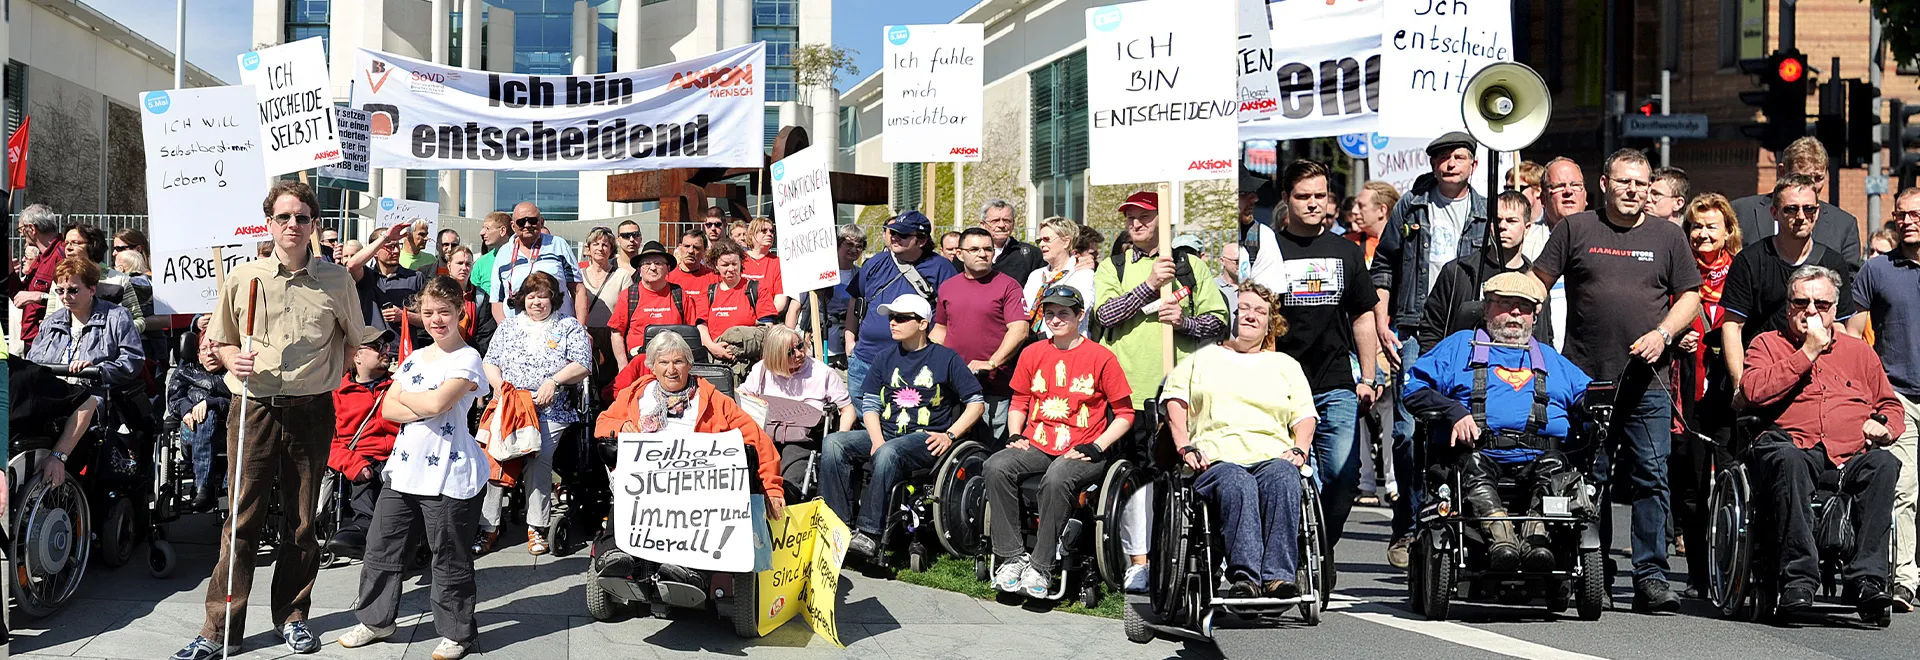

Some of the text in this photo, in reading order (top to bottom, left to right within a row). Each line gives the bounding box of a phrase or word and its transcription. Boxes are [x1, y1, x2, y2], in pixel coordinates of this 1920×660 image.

[1117, 32, 1173, 61] ICH
[1393, 24, 1507, 61] entscheide
[894, 51, 919, 70] Ich
[267, 61, 293, 91] ICH
[411, 70, 446, 84] SoVD
[902, 80, 937, 99] mich
[1125, 66, 1180, 92] BIN
[1411, 59, 1469, 94] mit
[488, 73, 633, 109] Ich bin
[709, 87, 754, 98] MENSCH
[256, 87, 323, 126] NTSCHEIDE
[342, 109, 366, 121] setzen
[887, 106, 968, 127] unsichtbar
[1093, 98, 1237, 129] ENTSCHEIDEND
[164, 117, 192, 135] ICH
[349, 120, 369, 132] einen
[411, 113, 709, 162] entscheidend
[162, 170, 206, 190] Leben
[778, 162, 829, 208] SANKTIONEN
[788, 198, 816, 226] GEGEN
[782, 226, 834, 262] BARRIEREN
[623, 438, 740, 462] Teilhabe
[720, 501, 751, 521] und
[629, 525, 736, 560] überall!
[766, 516, 813, 559] Wegen
[772, 557, 803, 588] sind
